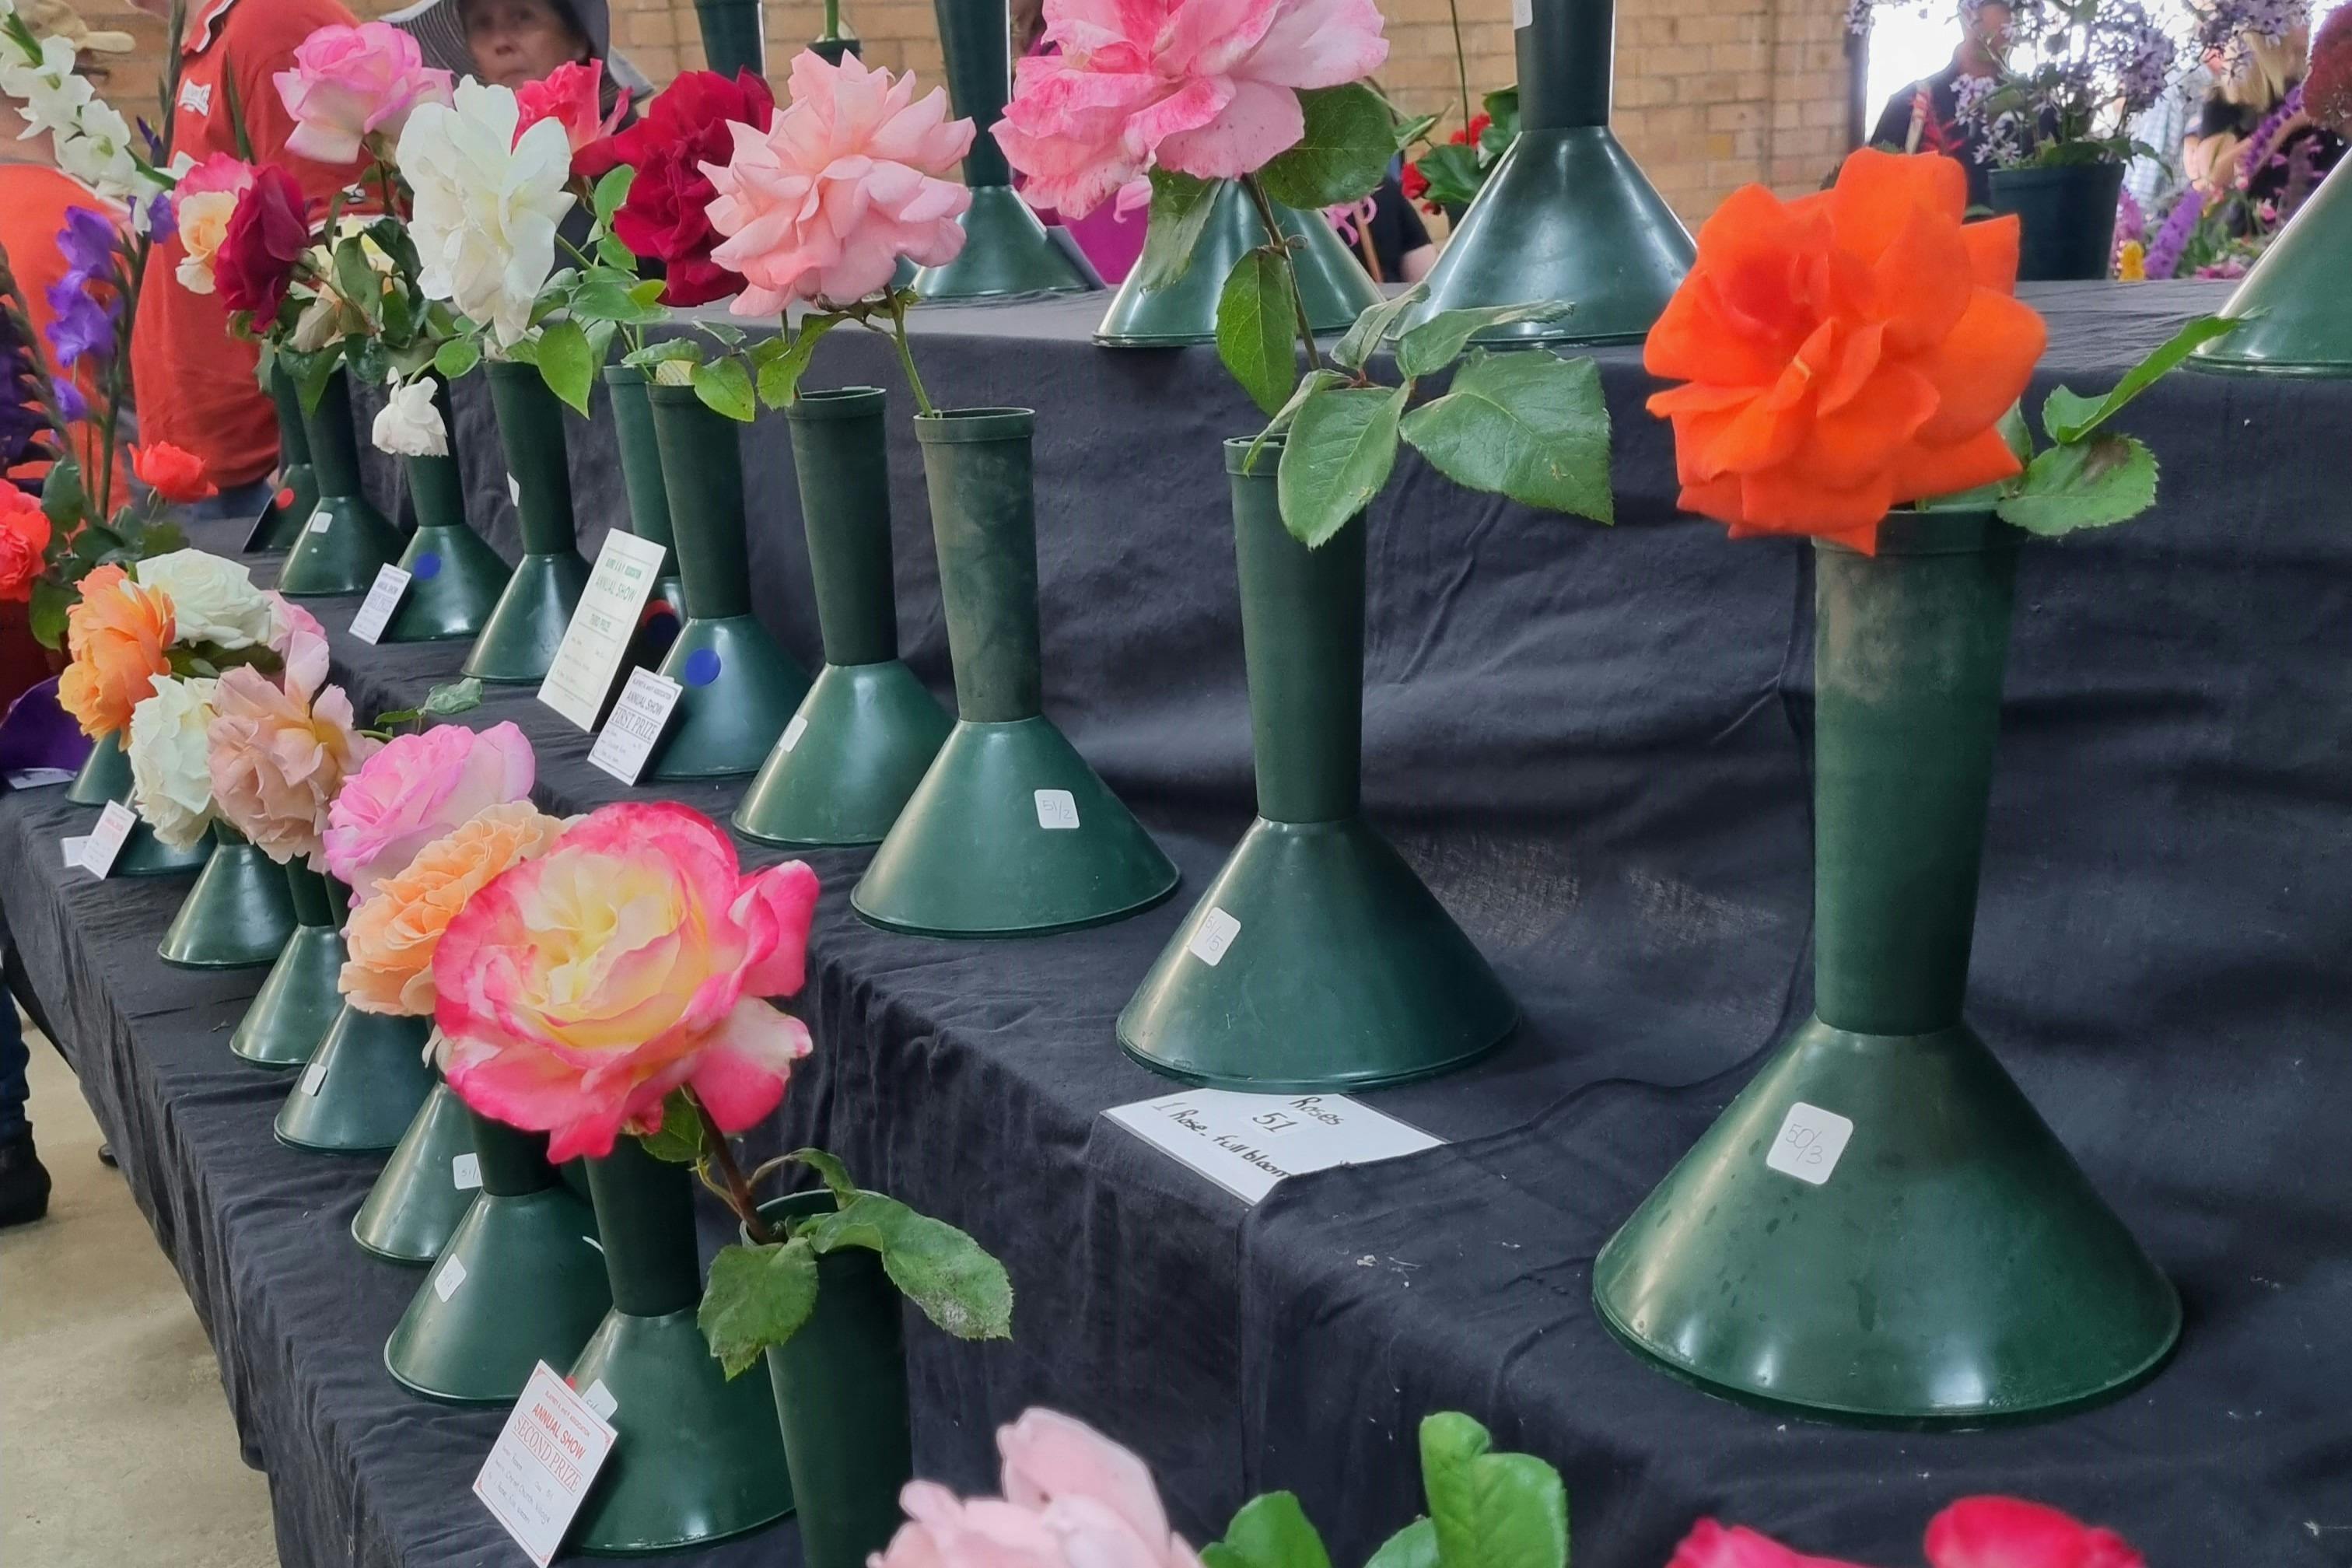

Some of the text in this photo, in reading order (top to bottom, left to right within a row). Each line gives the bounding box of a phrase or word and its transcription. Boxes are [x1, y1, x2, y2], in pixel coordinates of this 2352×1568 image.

[611, 705, 659, 741] FIRST PRIZE
[1151, 1101, 1186, 1111] 1
[1213, 1135, 1251, 1153] full
[1252, 1111, 1298, 1133] 51
[1288, 1096, 1345, 1125] Roses
[1786, 1123, 1823, 1164] 50/3
[532, 1403, 587, 1460] ANNUAL SHOW
[514, 1416, 582, 1493] SECOND PRIZE
